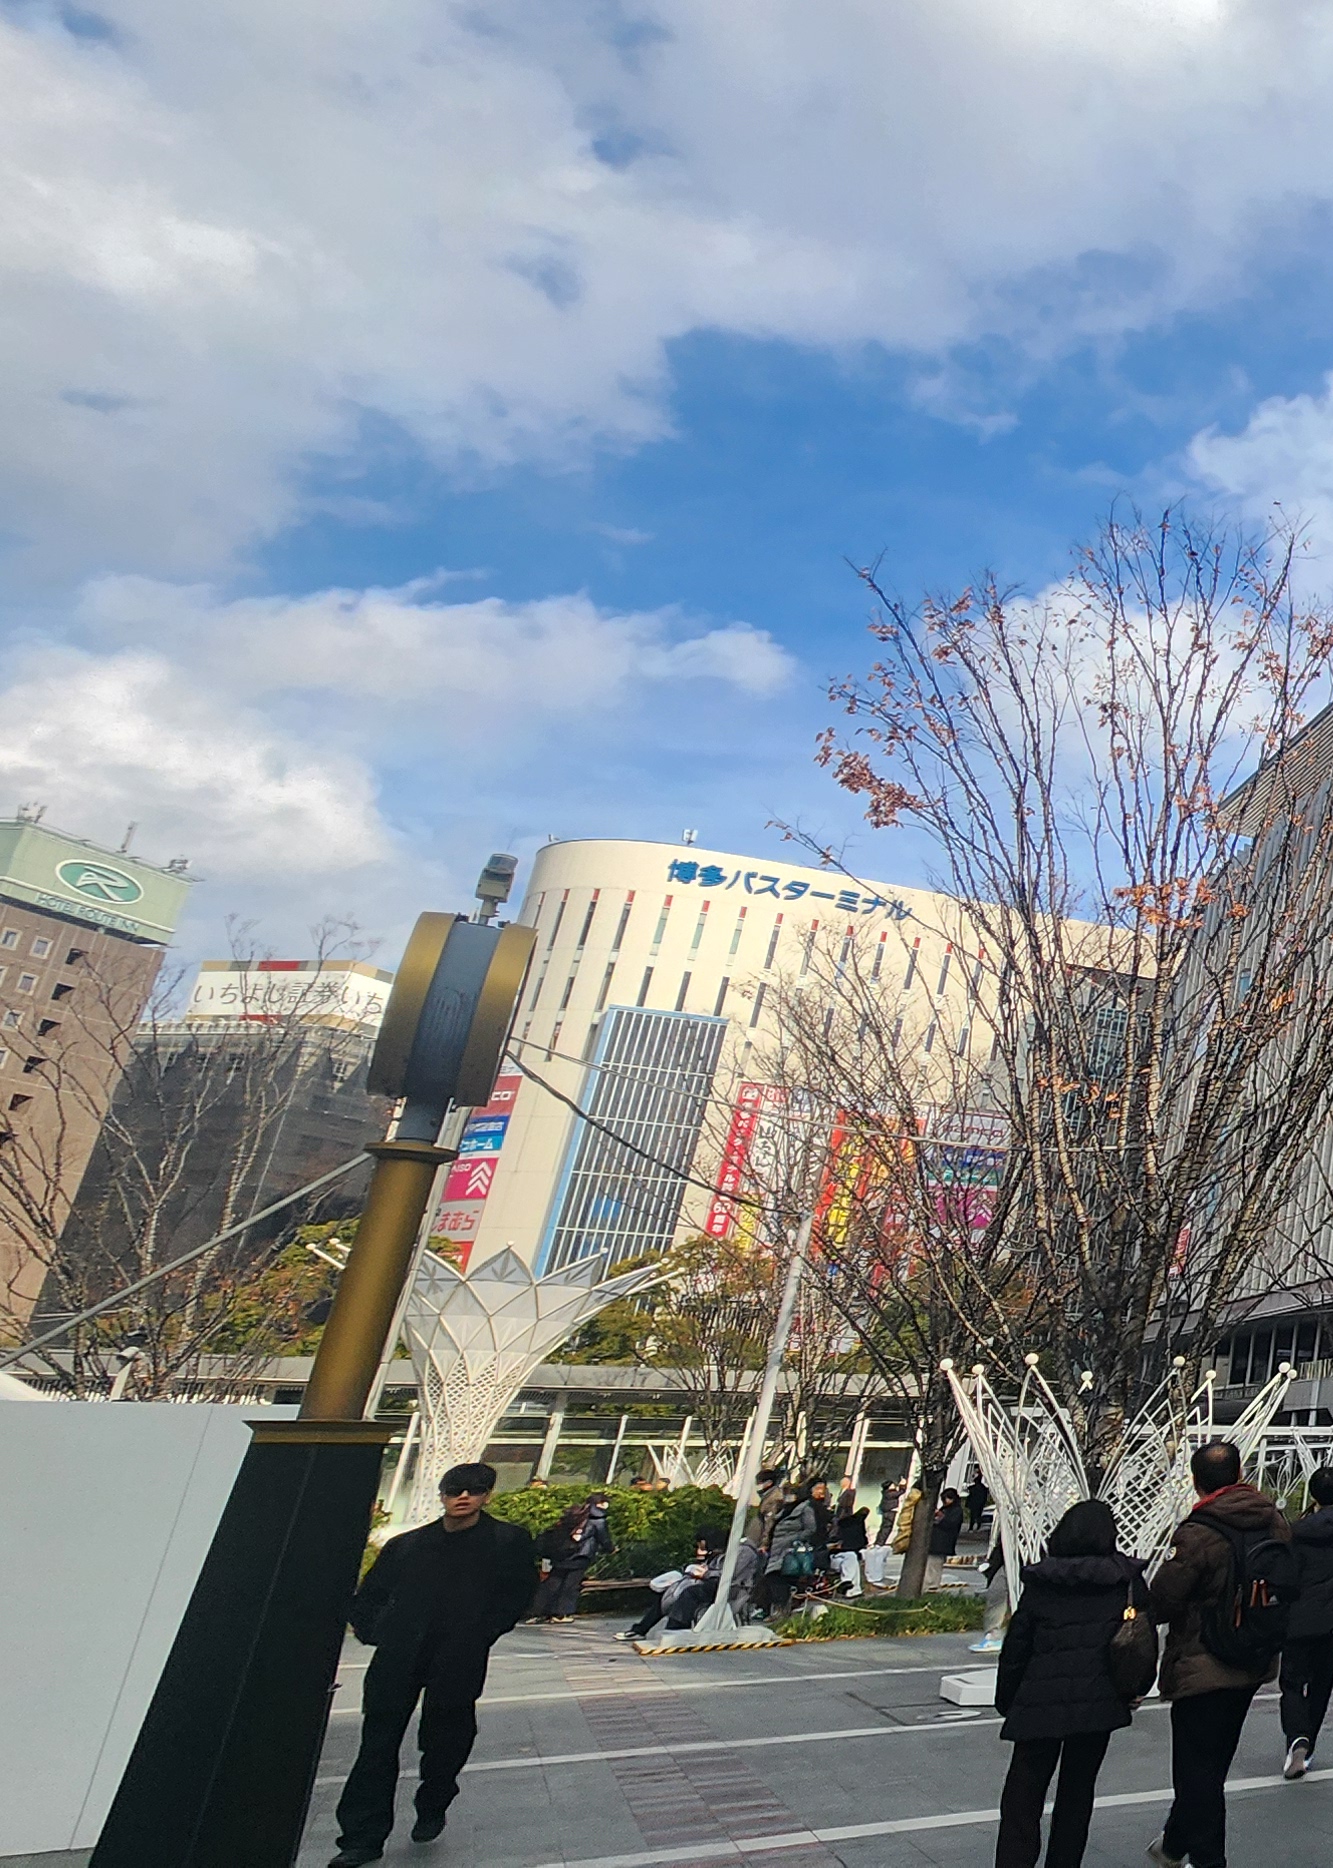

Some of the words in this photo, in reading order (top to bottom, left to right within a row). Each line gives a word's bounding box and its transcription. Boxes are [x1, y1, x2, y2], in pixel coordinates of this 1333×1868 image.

[667, 858, 913, 921] 博多バスターミナル
[36, 892, 74, 915] HOTEL
[75, 903, 118, 928] ROUTE
[194, 981, 339, 1005] いちよし証券
